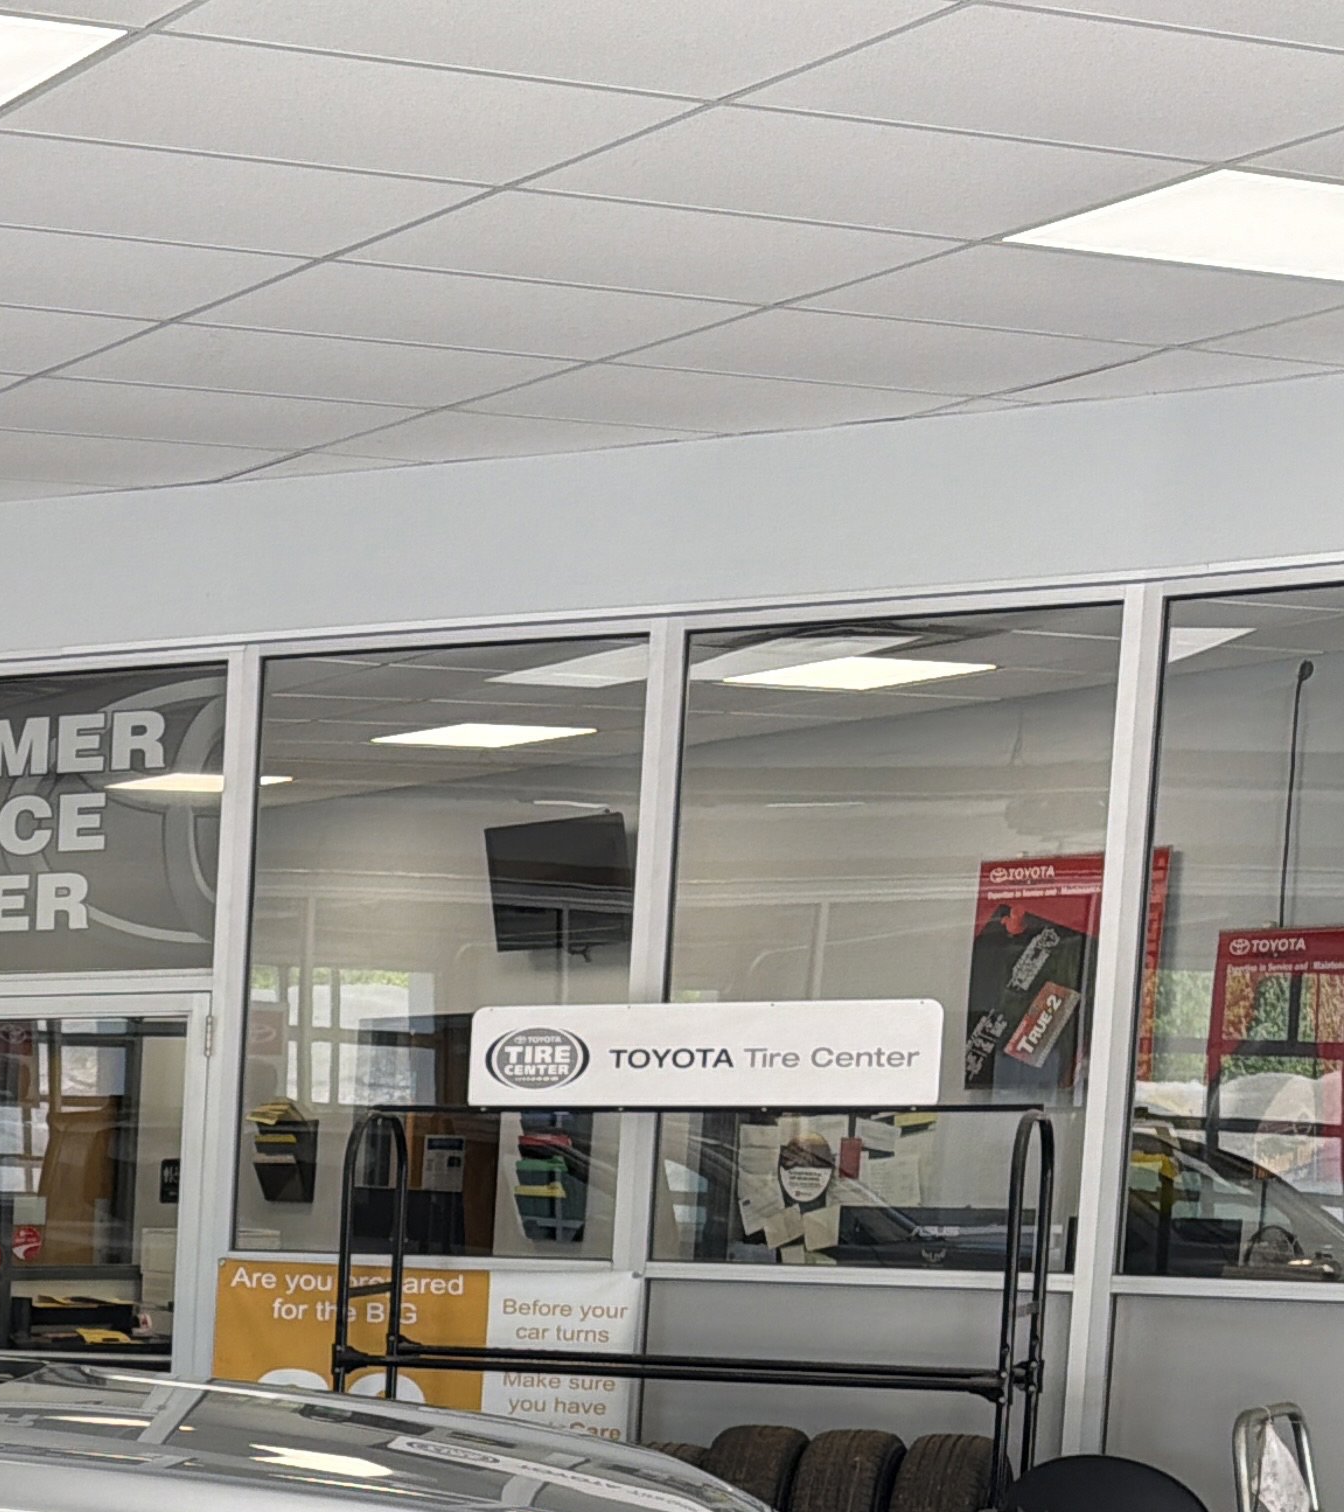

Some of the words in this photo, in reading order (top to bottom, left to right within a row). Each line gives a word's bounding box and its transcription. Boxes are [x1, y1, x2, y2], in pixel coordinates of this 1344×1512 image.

[1008, 865, 1055, 880] TOYOTA
[1251, 937, 1307, 953] TOYOTA
[527, 1035, 563, 1044] TOYOTA
[503, 1045, 572, 1064] TIRE
[609, 1047, 734, 1069] TOYOTA
[743, 1047, 801, 1069] Tire
[810, 1046, 921, 1069] Center
[503, 1064, 570, 1077] CENTER
[230, 1266, 277, 1289] Are
[286, 1274, 333, 1295] you
[272, 1297, 309, 1320] for
[366, 1302, 418, 1325] BG
[502, 1297, 573, 1317] Before
[580, 1303, 629, 1322] your
[515, 1325, 550, 1340] car
[556, 1324, 610, 1343] turns
[502, 1371, 561, 1389] Make
[568, 1377, 616, 1392] sure
[508, 1398, 547, 1415] you
[553, 1396, 607, 1416] have
